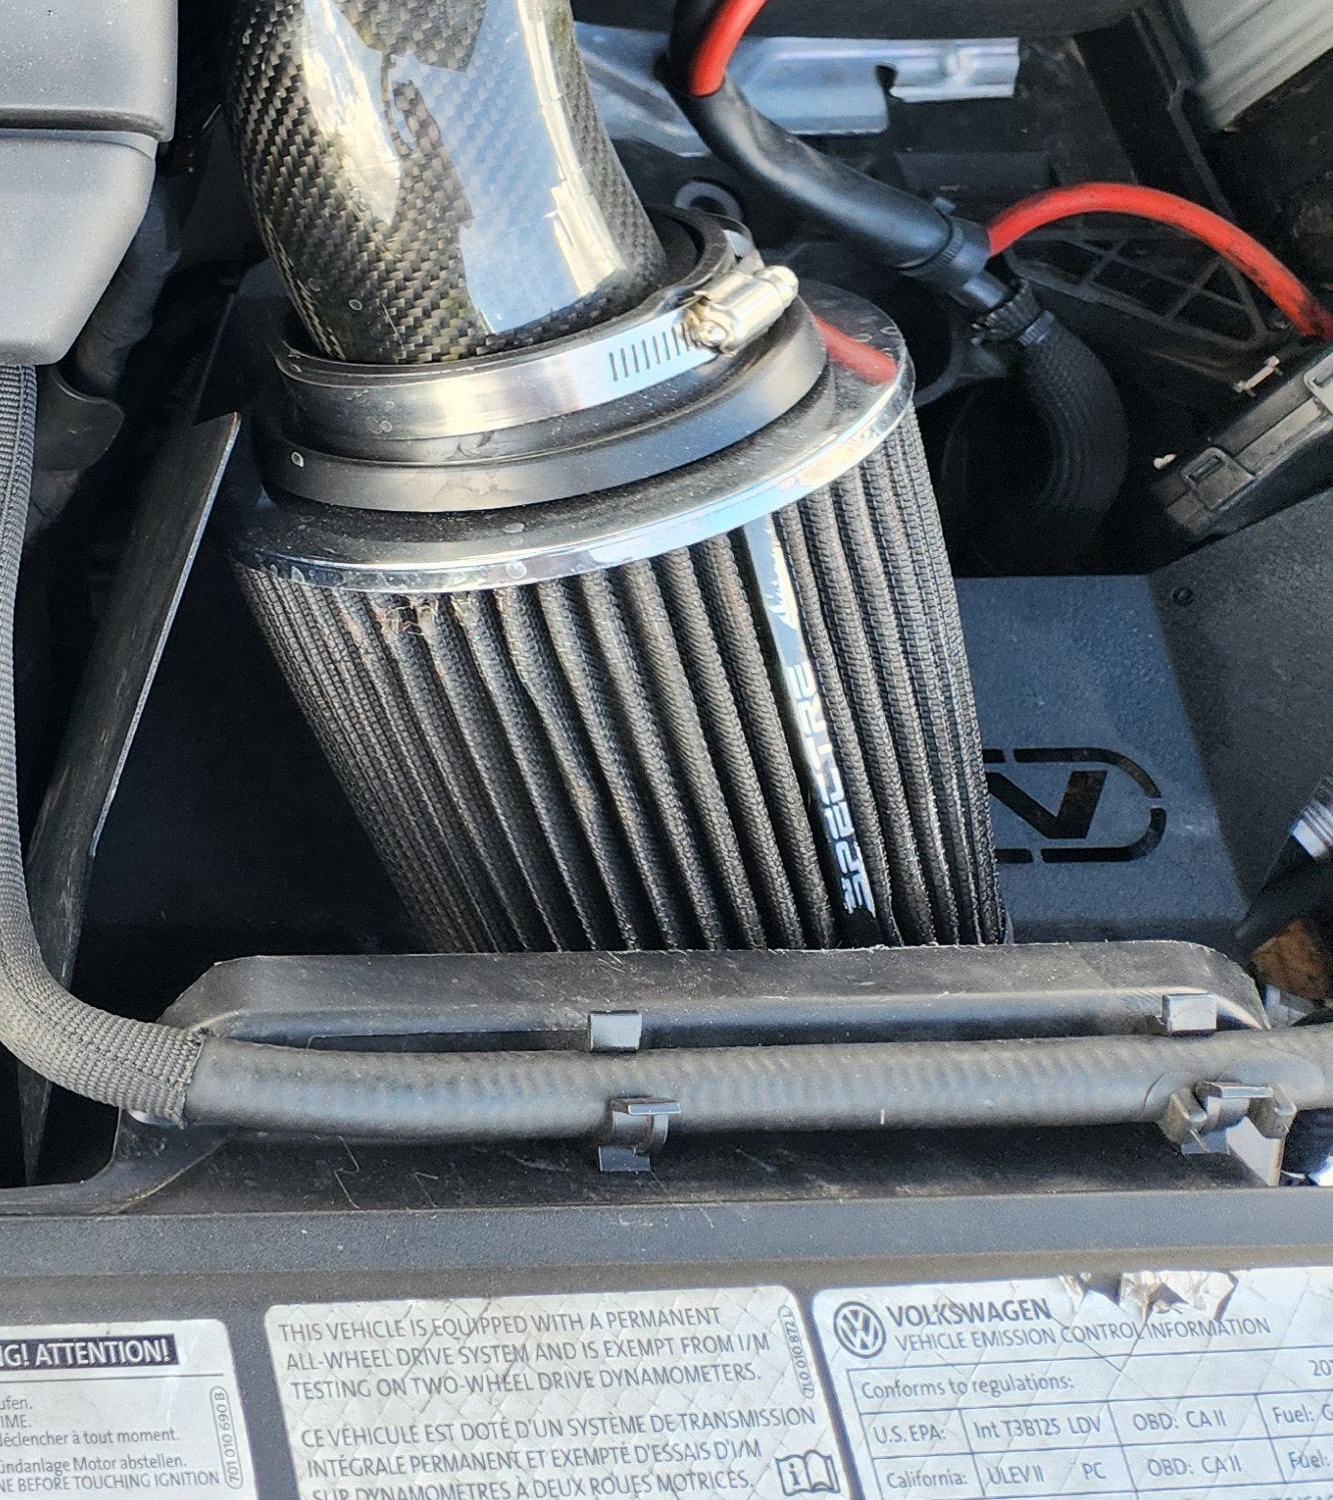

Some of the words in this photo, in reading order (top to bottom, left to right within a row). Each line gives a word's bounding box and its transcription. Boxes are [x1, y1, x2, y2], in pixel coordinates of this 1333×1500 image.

[278, 1323, 322, 1342] THIS
[326, 1320, 406, 1340] VEHICLE
[410, 1319, 430, 1339] IS
[431, 1315, 527, 1338] EQUIPPED
[533, 1313, 583, 1332] WITH
[590, 1313, 603, 1330] A
[606, 1307, 719, 1329] PERMANENT
[886, 1298, 1055, 1327] VOLKSWAGEN
[894, 1332, 967, 1351] VEHICLE
[971, 1328, 1056, 1348] EMISSION
[1061, 1321, 1147, 1344] CONTROL
[1145, 1318, 1270, 1338] INFORMATION
[36, 1339, 169, 1365] ATTENTION!
[287, 1349, 392, 1370] ALL-WHEEL
[396, 1347, 454, 1368] DRIVE
[458, 1343, 530, 1364] SYSTEM
[536, 1342, 576, 1361] AND
[582, 1341, 599, 1359] IS
[603, 1338, 677, 1357] EXEMPT
[681, 1335, 734, 1354] FROM
[738, 1333, 769, 1353] I/M
[290, 1379, 372, 1400] TESTING
[377, 1376, 407, 1397] ON
[411, 1371, 534, 1397] TWO-WHEEL
[537, 1371, 595, 1390] DRIVE
[599, 1363, 761, 1388] DYNAMOMETERS.
[861, 1379, 945, 1399] Conforms
[948, 1379, 967, 1395] to
[972, 1374, 1073, 1397] regulations:
[1133, 1412, 1179, 1431] OBD:
[1186, 1410, 1215, 1428] CA
[1272, 1404, 1314, 1423] Fuel:
[72, 1431, 80, 1444] à
[83, 1430, 113, 1444] tout
[117, 1428, 181, 1443] moment.
[302, 1429, 324, 1448] CE
[327, 1423, 420, 1447] VÉHICULE
[425, 1424, 454, 1443] EST
[461, 1417, 512, 1441] DOTÉ
[515, 1419, 563, 1438] D'UN
[567, 1413, 646, 1436] SYSTÈME
[650, 1414, 679, 1432] DE
[679, 1407, 815, 1431] TRANSMISSION
[873, 1426, 907, 1444] U.S.
[909, 1424, 946, 1441] EPA:
[73, 1457, 116, 1477] Motor
[120, 1454, 188, 1473] abstellen.
[1147, 1458, 1193, 1476] OBD:
[1201, 1455, 1230, 1473] CA
[1288, 1450, 1330, 1469] Fuel:
[18, 1475, 70, 1492] BEFORE
[73, 1473, 150, 1489] TOUCHING
[154, 1471, 219, 1486] IGNITION
[886, 1469, 967, 1488] California:
[986, 1465, 1035, 1487] ULEV
[1081, 1462, 1106, 1480] PC
